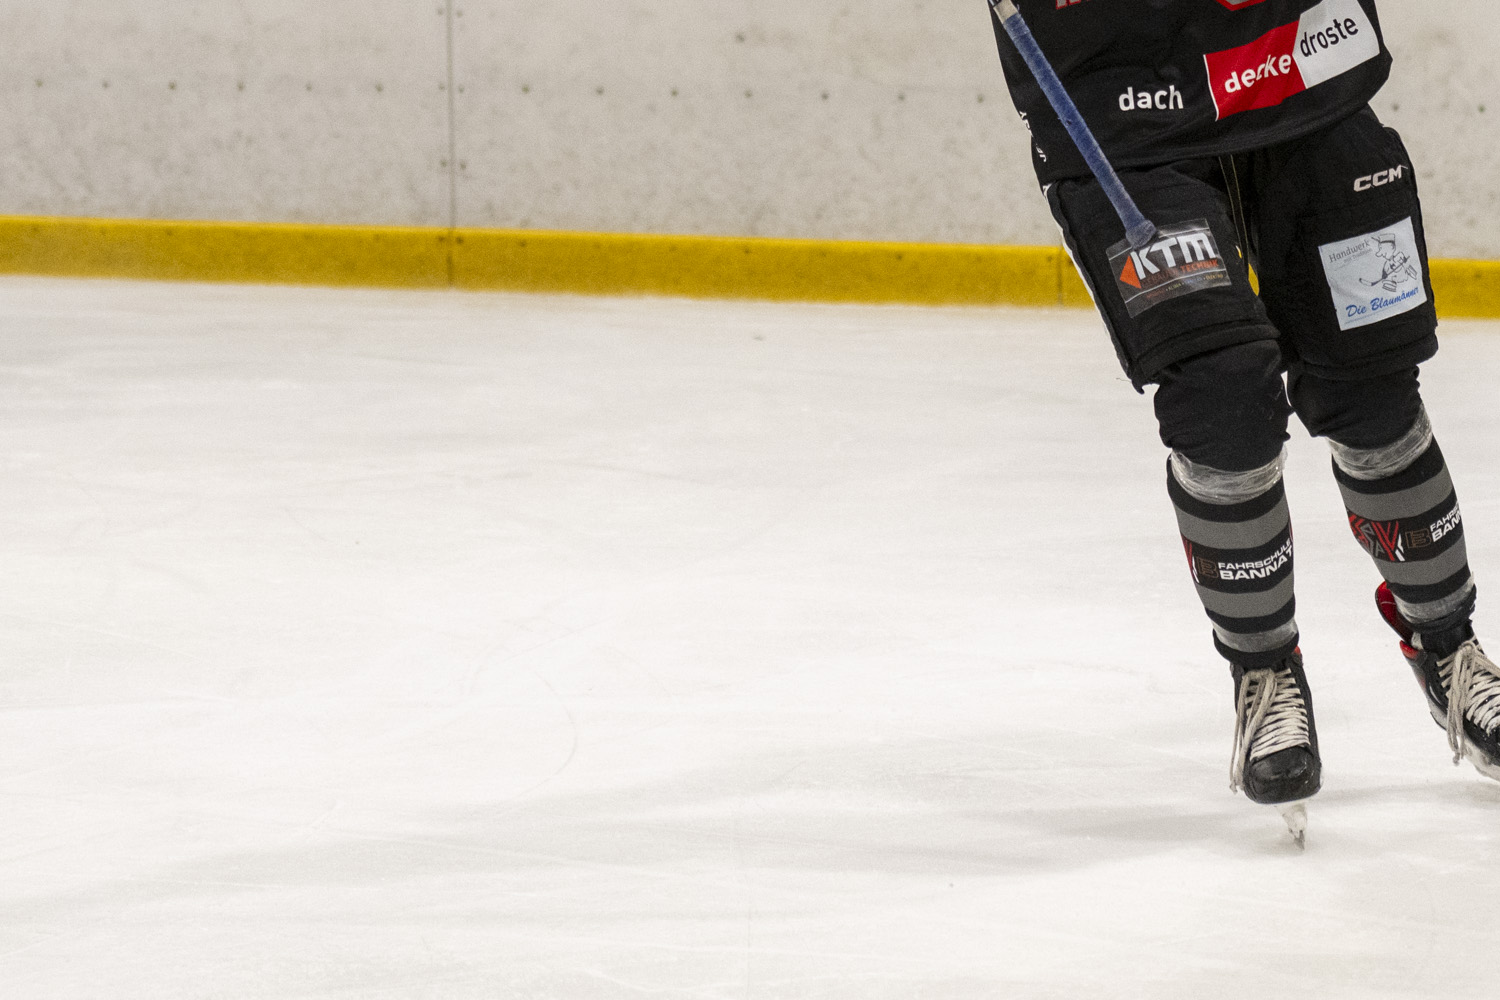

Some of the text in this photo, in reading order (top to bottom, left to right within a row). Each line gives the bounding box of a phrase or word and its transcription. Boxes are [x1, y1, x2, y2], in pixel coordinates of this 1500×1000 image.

[1118, 85, 1184, 112] dach
[1300, 16, 1359, 58] droste
[1353, 164, 1403, 192] CCM
[1130, 233, 1217, 280] KTM
[1328, 239, 1370, 263] Handwerk
[1346, 287, 1419, 317] Die Blaumänner
[1218, 538, 1290, 570] FAHRSCHULE
[1219, 545, 1293, 580] BANNAT
